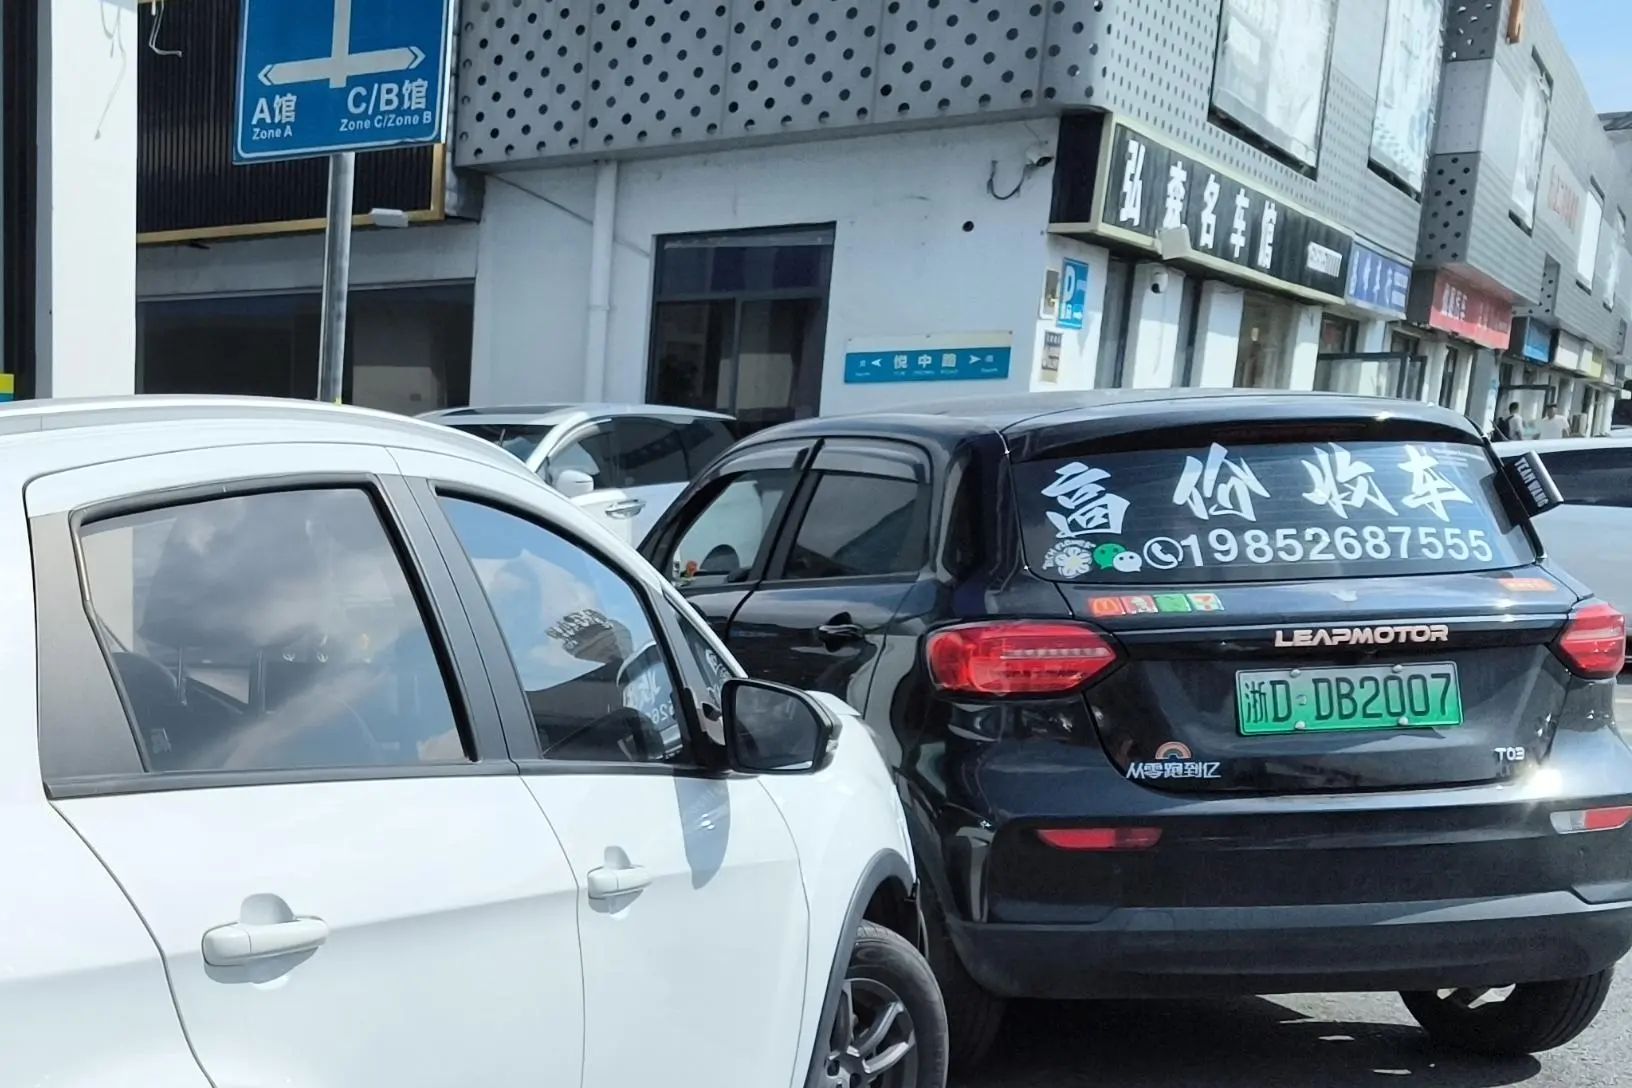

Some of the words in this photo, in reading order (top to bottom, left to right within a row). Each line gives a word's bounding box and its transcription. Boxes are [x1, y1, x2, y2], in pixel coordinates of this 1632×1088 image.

[347, 78, 428, 115] C/B馆
[251, 92, 297, 125] A馆
[252, 126, 282, 140] Zone
[283, 125, 293, 137] A
[339, 117, 371, 132] Zone
[374, 113, 418, 128] C/Zone
[422, 110, 432, 124] B
[1181, 525, 1493, 567] 19852687555
[1274, 624, 1449, 648] LEAPMOTOR
[1493, 746, 1525, 761] T03
[1126, 762, 1221, 779] 从零跑到亿
